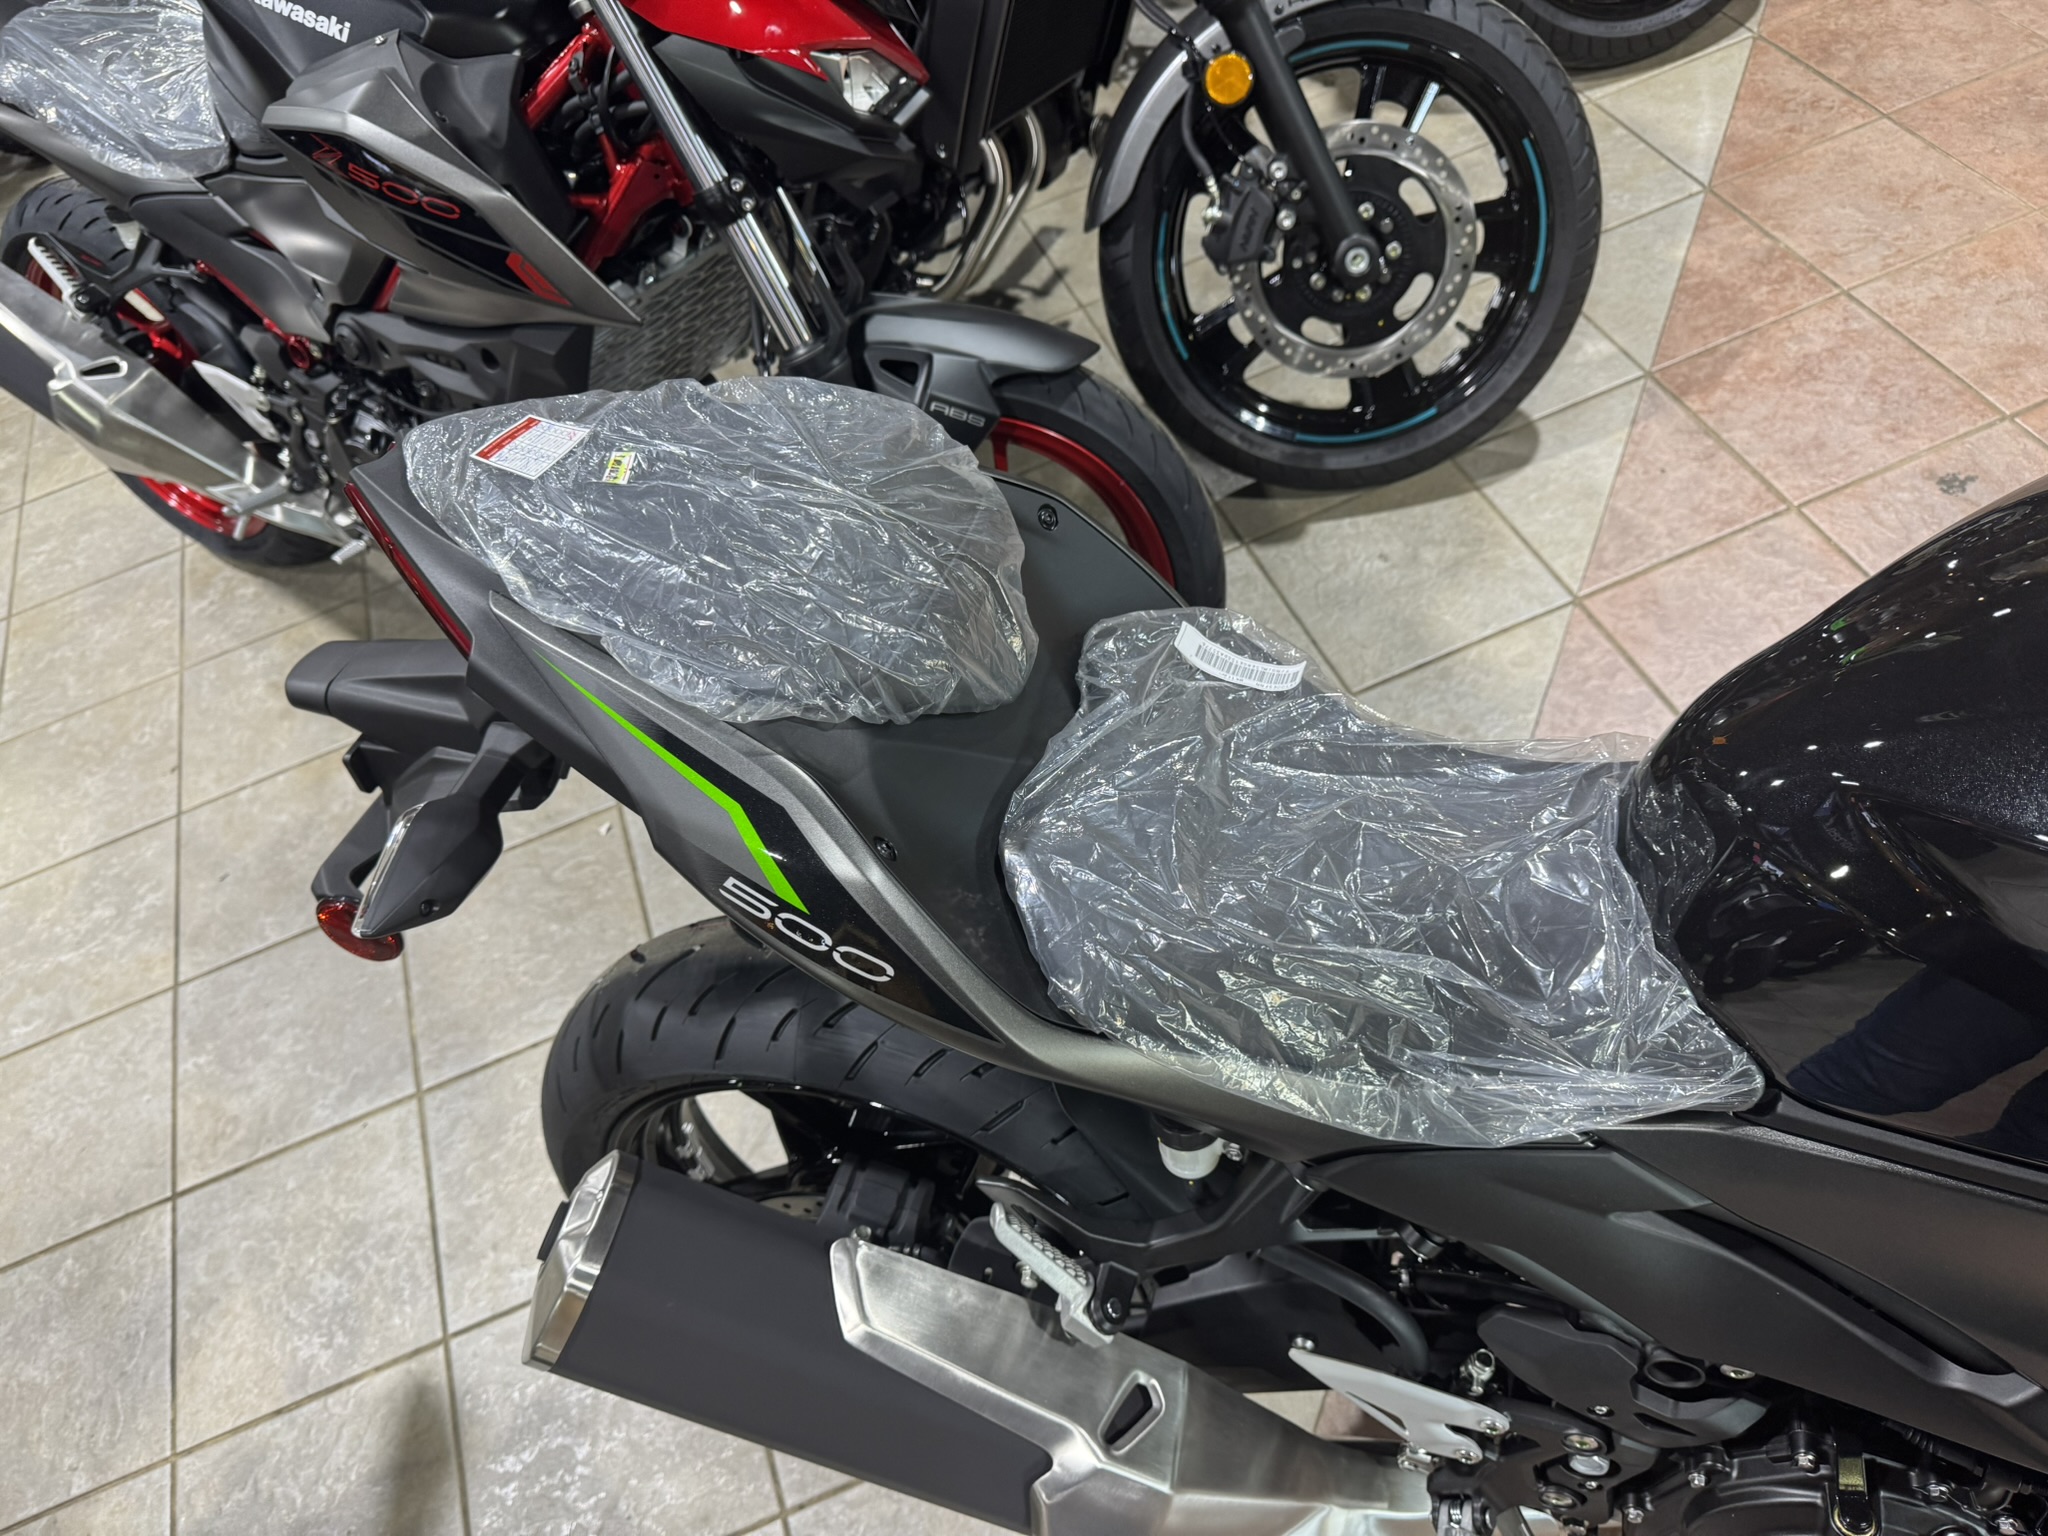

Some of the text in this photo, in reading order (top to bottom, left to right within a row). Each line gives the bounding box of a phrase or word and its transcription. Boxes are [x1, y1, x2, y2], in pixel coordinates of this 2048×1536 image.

[251, 0, 351, 43] awasaki
[930, 401, 986, 428] ABS
[719, 876, 895, 983] 500
